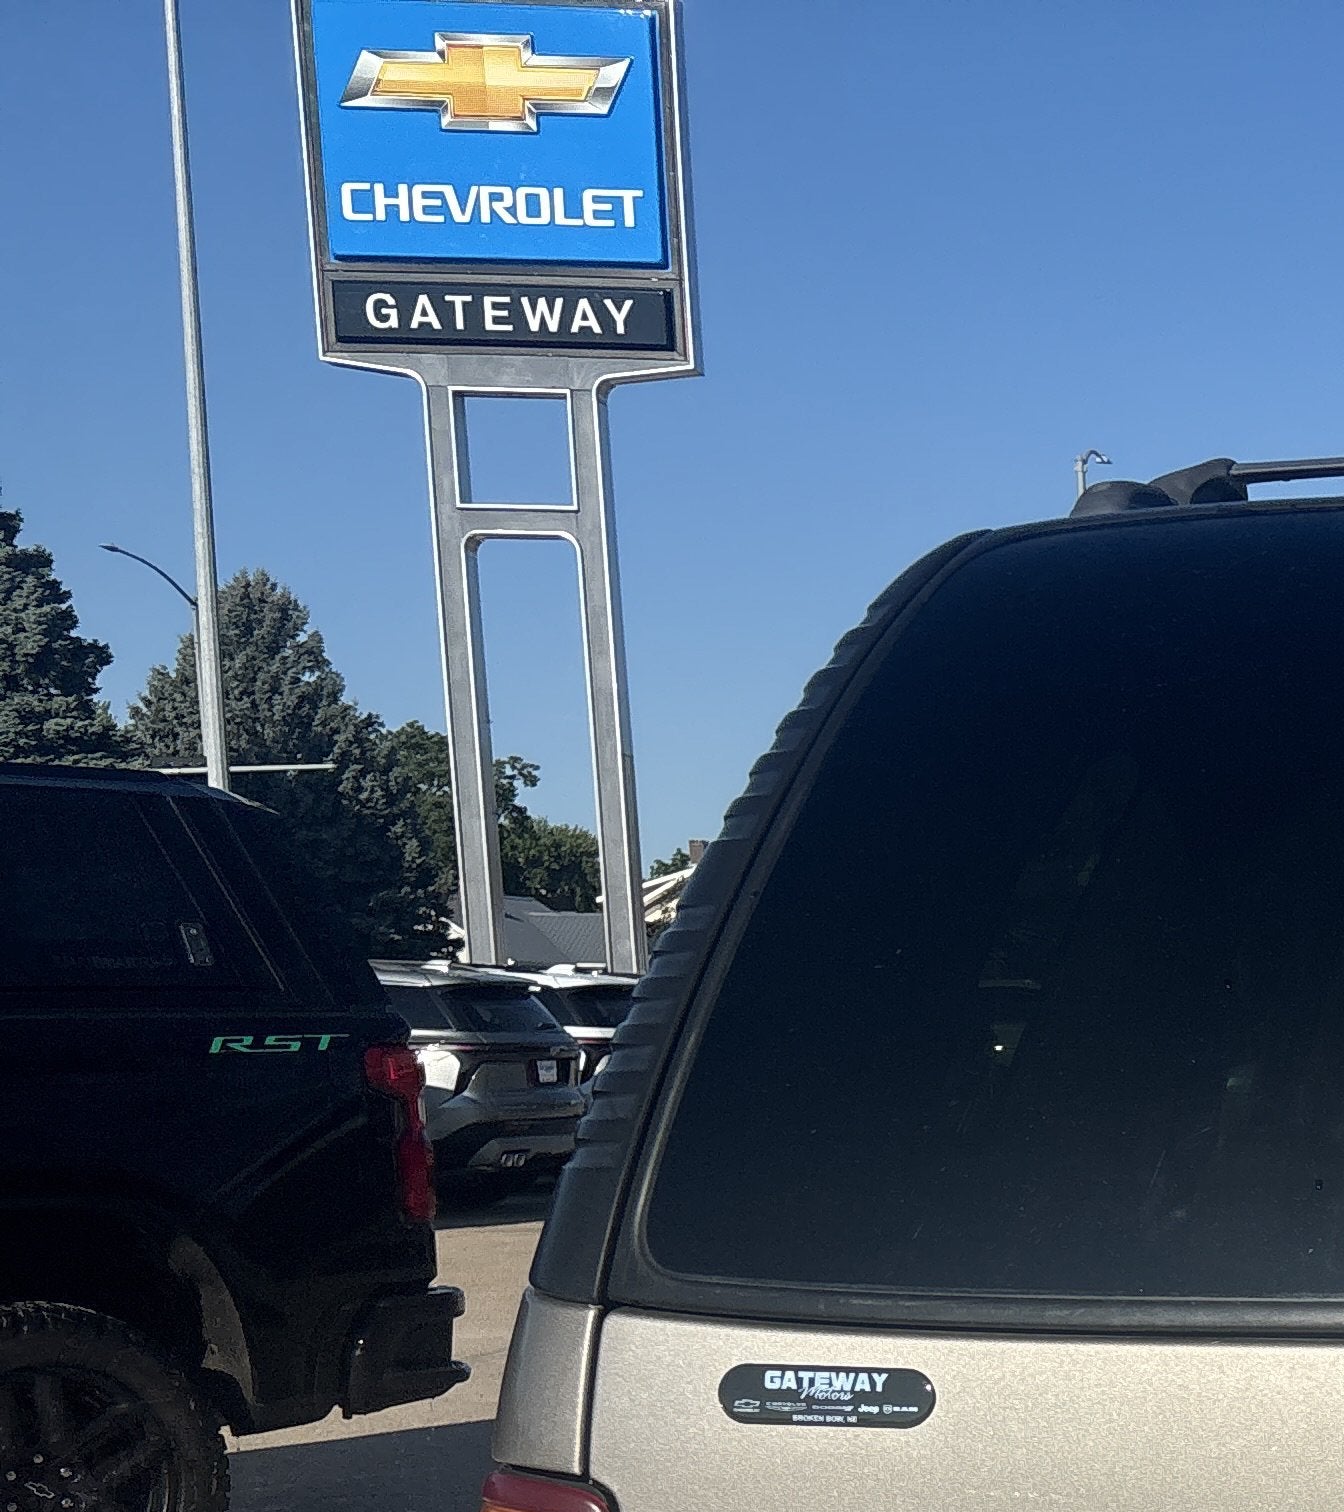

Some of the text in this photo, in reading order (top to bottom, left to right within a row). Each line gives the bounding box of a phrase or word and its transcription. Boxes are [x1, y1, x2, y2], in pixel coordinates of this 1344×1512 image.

[340, 182, 644, 228] CHEVROLET
[365, 292, 634, 335] GATEWAY
[208, 1033, 350, 1054] RST
[764, 1371, 889, 1392] GATEWAY
[798, 1384, 854, 1401] Motors
[858, 1404, 880, 1415] Jeep
